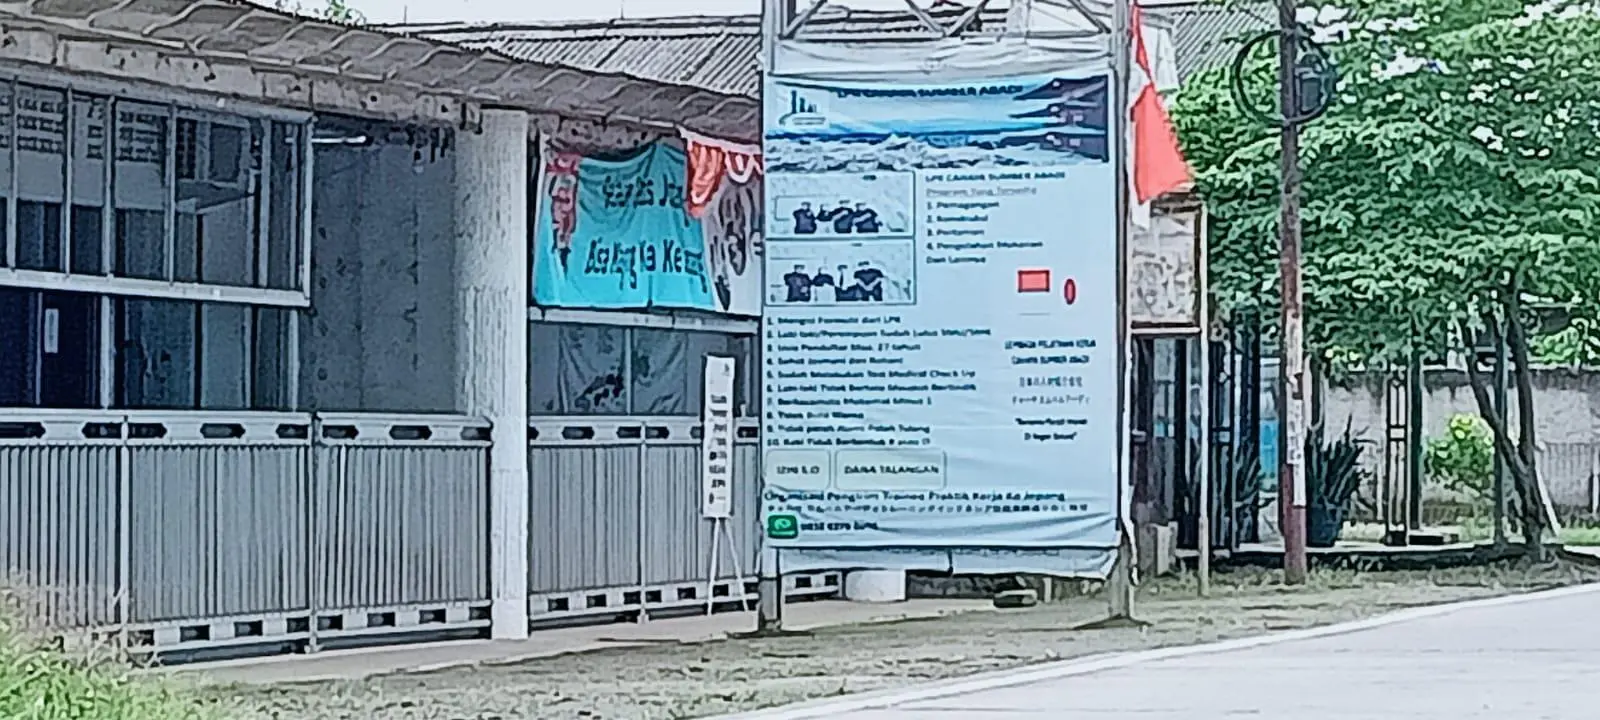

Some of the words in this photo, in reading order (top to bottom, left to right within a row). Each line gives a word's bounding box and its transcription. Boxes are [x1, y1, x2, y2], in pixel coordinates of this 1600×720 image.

[918, 87, 976, 97] SUMBER
[979, 85, 1023, 95] ABADI
[988, 172, 1031, 181] SUMBER
[1034, 171, 1065, 179] ABADI
[861, 316, 881, 324] dari
[880, 329, 910, 337] Sudah
[913, 329, 938, 337] Lulus
[777, 371, 807, 379] Sudah
[888, 370, 927, 379] Medical
[929, 370, 958, 379] Check
[820, 384, 846, 393] Tidak
[832, 411, 864, 420] Warna
[868, 424, 895, 433] Patah
[898, 424, 931, 434] Tulang
[807, 438, 833, 446] Tidak
[836, 438, 886, 446] Berbentuk
[880, 464, 940, 475] TALANGAN
[928, 490, 970, 501] Praktik
[972, 492, 1003, 502] Kerja
[1023, 491, 1066, 502] Jepang
